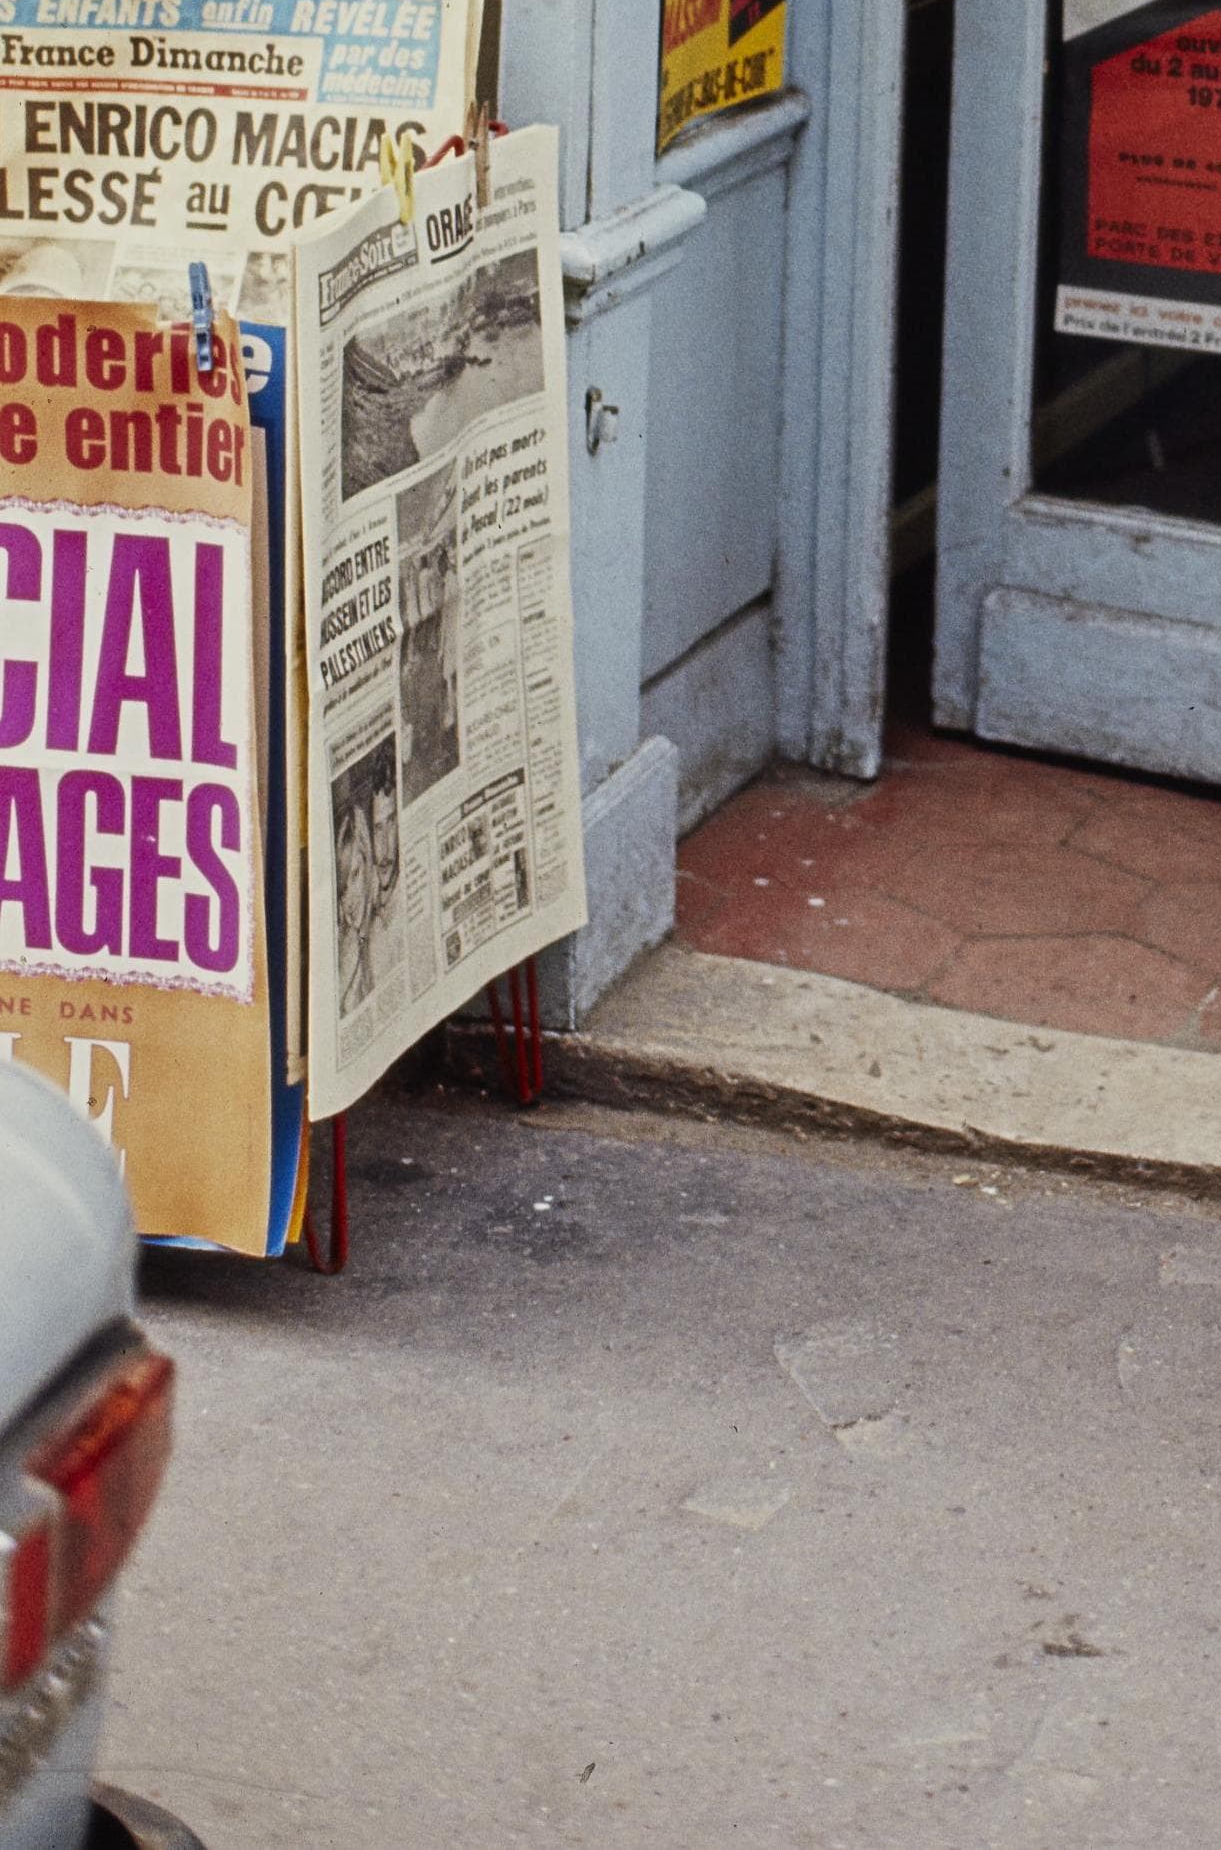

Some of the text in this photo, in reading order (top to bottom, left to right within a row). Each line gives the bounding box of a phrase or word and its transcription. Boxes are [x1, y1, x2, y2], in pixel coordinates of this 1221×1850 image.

[2, 34, 305, 78] France Dimanche
[329, 37, 425, 70] par des
[1130, 55, 1161, 77] du
[1167, 57, 1183, 78] 2
[1190, 63, 1221, 81] au
[25, 100, 427, 174] ENRICO MACIAS
[186, 181, 231, 216] au
[1095, 218, 1146, 238] PARC
[1156, 225, 1195, 244] DES
[1095, 237, 1160, 259] PORTE
[1170, 245, 1196, 263] DE
[65, 398, 246, 487] entier
[354, 535, 393, 582] ENTRE
[359, 587, 371, 621] ET
[373, 576, 392, 613] LES
[320, 616, 397, 691] PALESTINIENS
[59, 1001, 134, 1025] DANS
